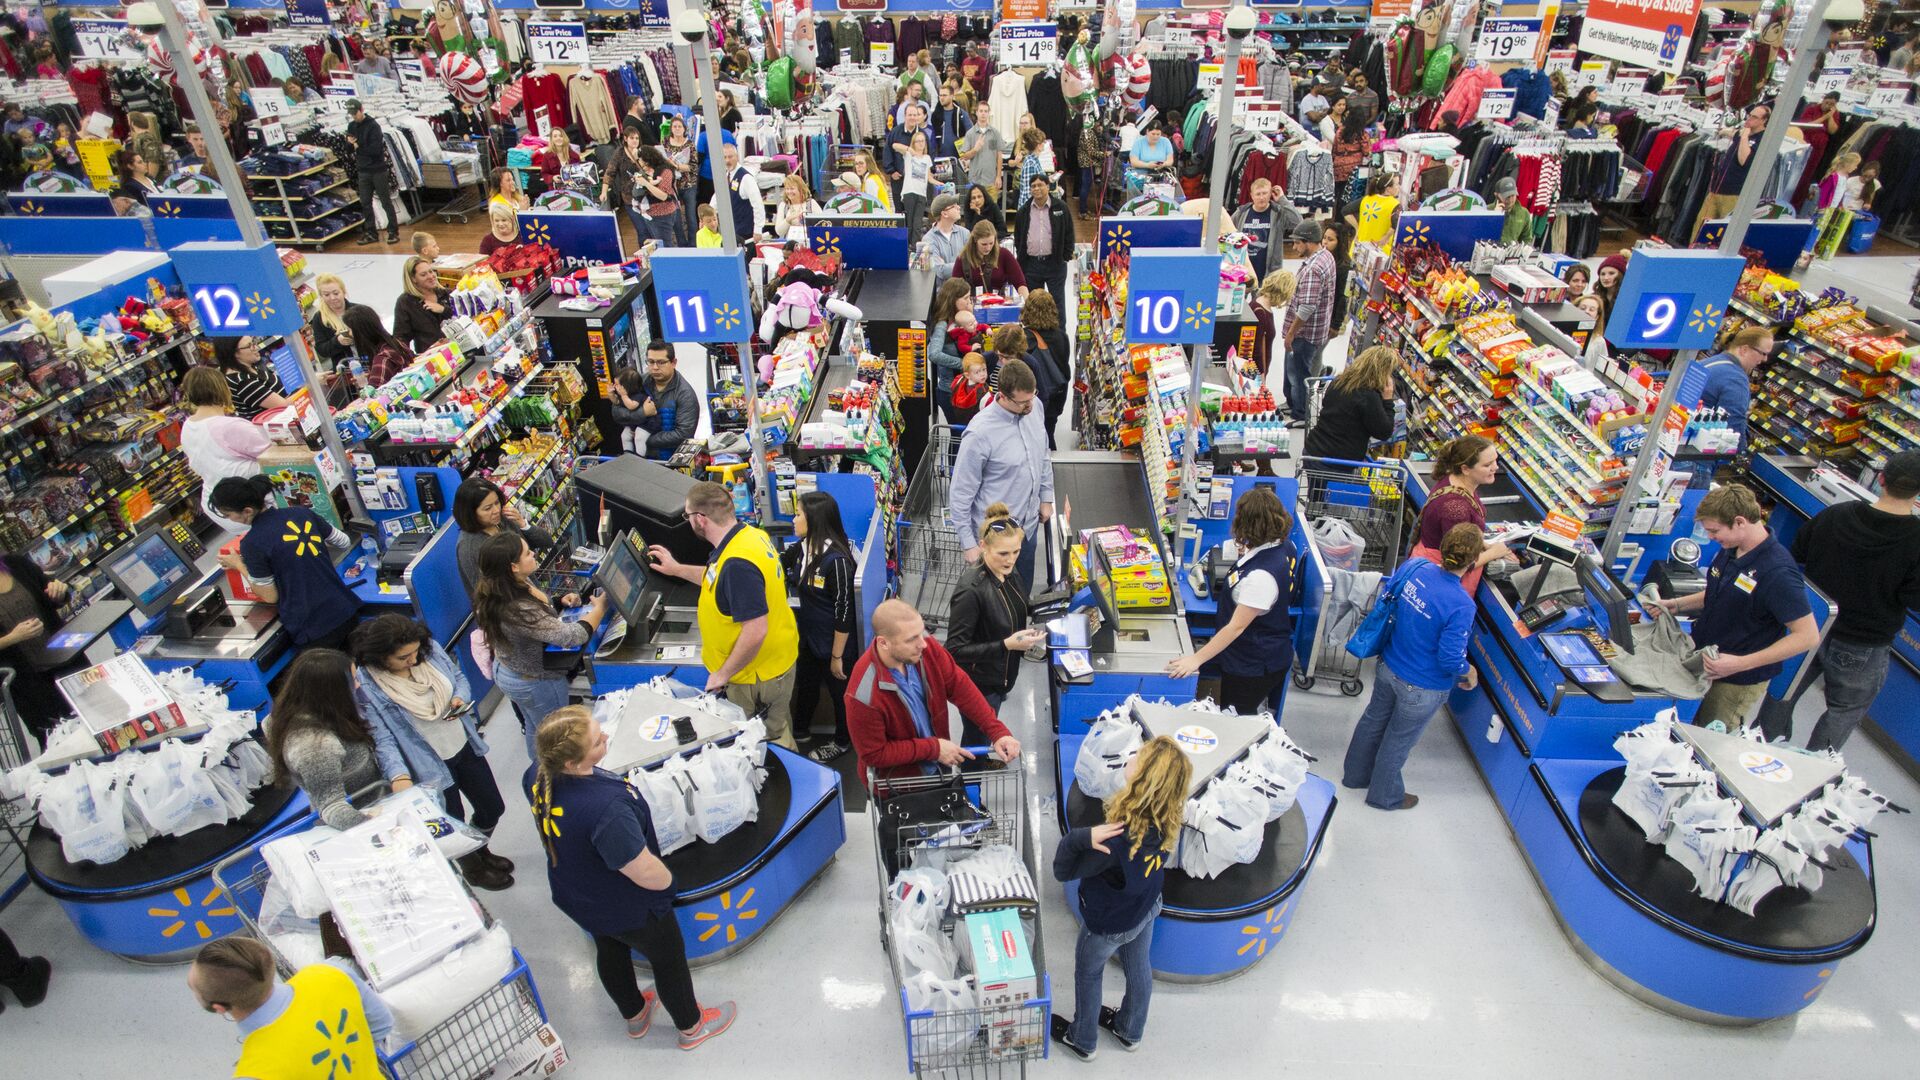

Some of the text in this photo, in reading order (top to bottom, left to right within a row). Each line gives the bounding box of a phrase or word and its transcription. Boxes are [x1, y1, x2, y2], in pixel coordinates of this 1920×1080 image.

[540, 29, 572, 37] Low Price
[1013, 29, 1044, 38] Low Price
[1496, 24, 1529, 32] Low Price
[1588, 27, 1658, 55] Get the Walmart App today.
[843, 219, 897, 228] BENTONVILLE
[566, 256, 604, 269] Price
[195, 287, 250, 327] 12
[666, 295, 707, 333] 11
[1136, 296, 1181, 335] 10
[1641, 298, 1677, 339] 9
[1485, 654, 1503, 686] money.
[1502, 681, 1516, 705] Live
[1513, 700, 1536, 735] better.
[552, 1045, 567, 1069] T-fal
